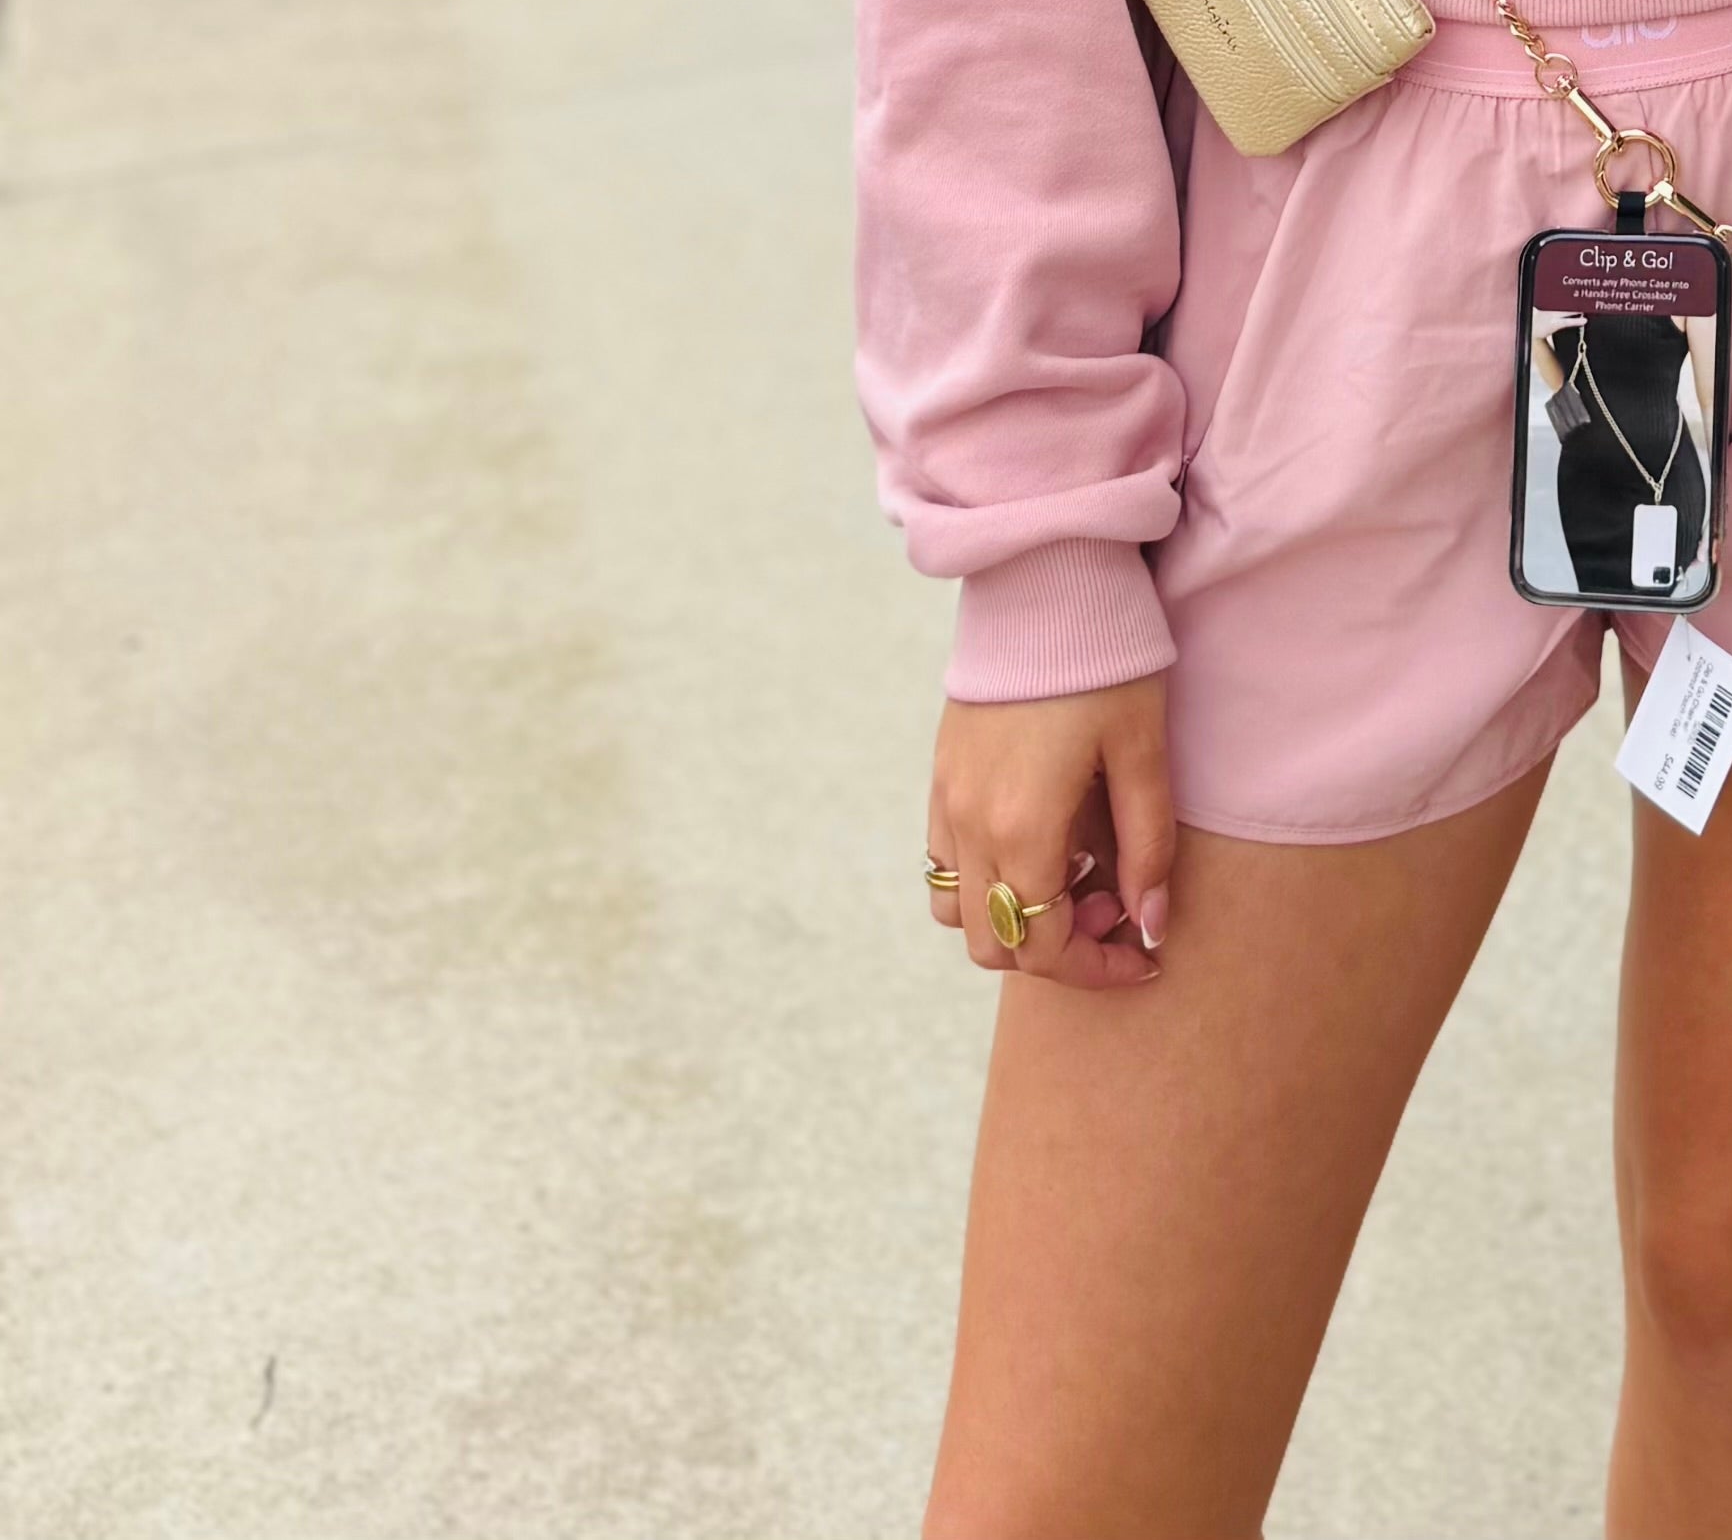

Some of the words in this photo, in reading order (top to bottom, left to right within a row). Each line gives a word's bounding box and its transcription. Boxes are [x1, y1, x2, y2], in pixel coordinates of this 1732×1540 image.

[1580, 245, 1618, 273] Clip
[1622, 249, 1636, 268] &
[1641, 250, 1673, 270] Go!
[1562, 275, 1601, 287] Converts
[1602, 279, 1618, 288] any
[1620, 277, 1648, 288] Phone
[1649, 278, 1670, 289] Case
[1671, 280, 1690, 290] into
[1573, 289, 1580, 298] a
[1632, 290, 1677, 303] Crossbody
[1595, 300, 1623, 311] Phone
[1625, 301, 1655, 312] Carrier
